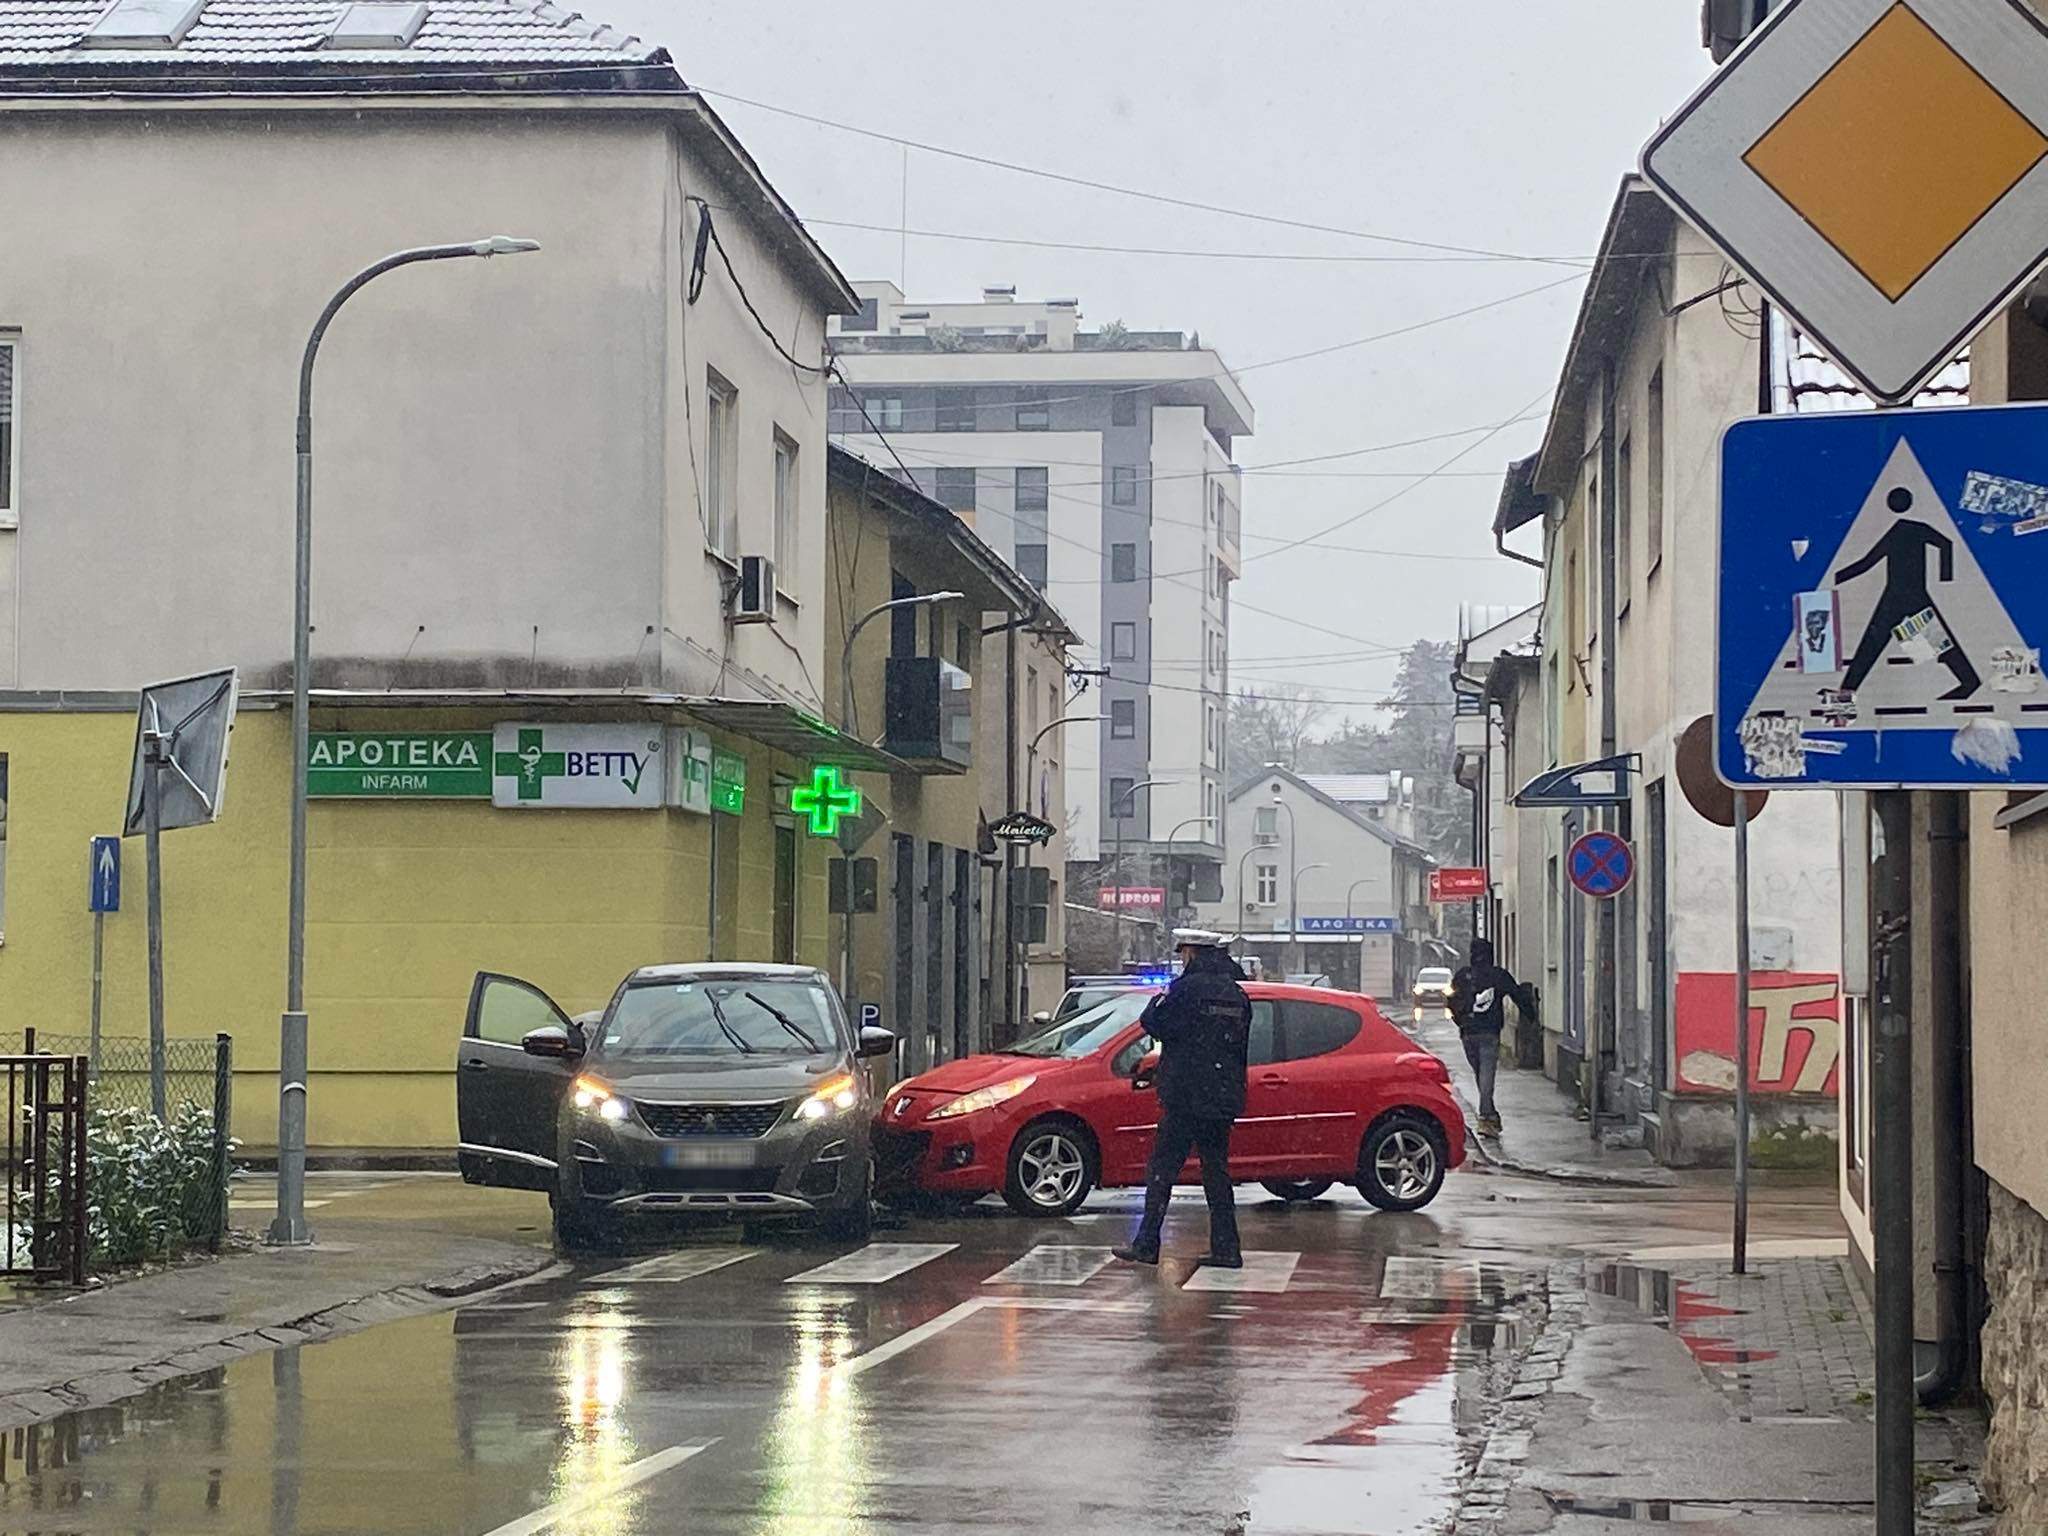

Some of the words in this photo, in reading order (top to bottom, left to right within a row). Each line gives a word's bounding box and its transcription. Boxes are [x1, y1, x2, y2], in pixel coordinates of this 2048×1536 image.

[309, 740, 479, 765] APOTEKA
[362, 775, 428, 789] INFARM
[862, 1005, 879, 1026] P
